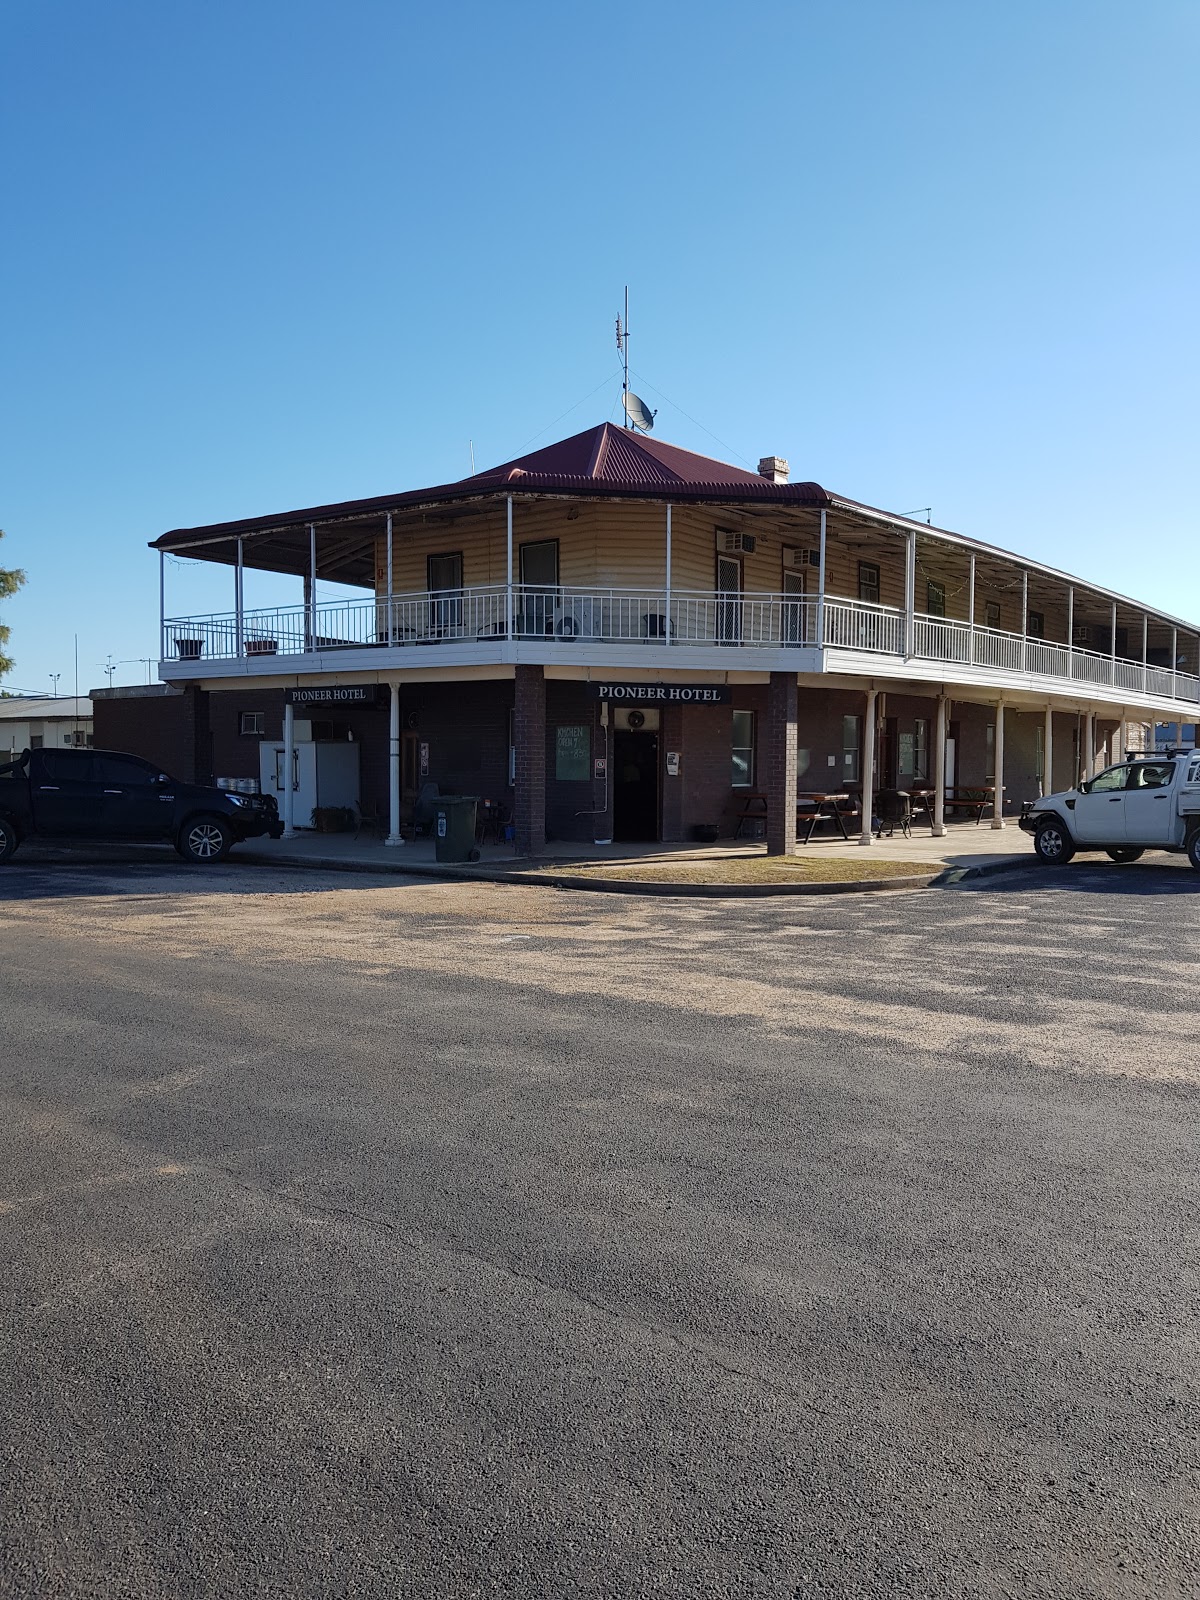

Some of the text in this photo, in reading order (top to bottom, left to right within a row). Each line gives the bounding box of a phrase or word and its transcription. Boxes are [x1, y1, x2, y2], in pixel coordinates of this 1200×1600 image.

[292, 689, 366, 701] PIONEER HOTEL
[599, 686, 721, 701] PIONEER HOTEL
